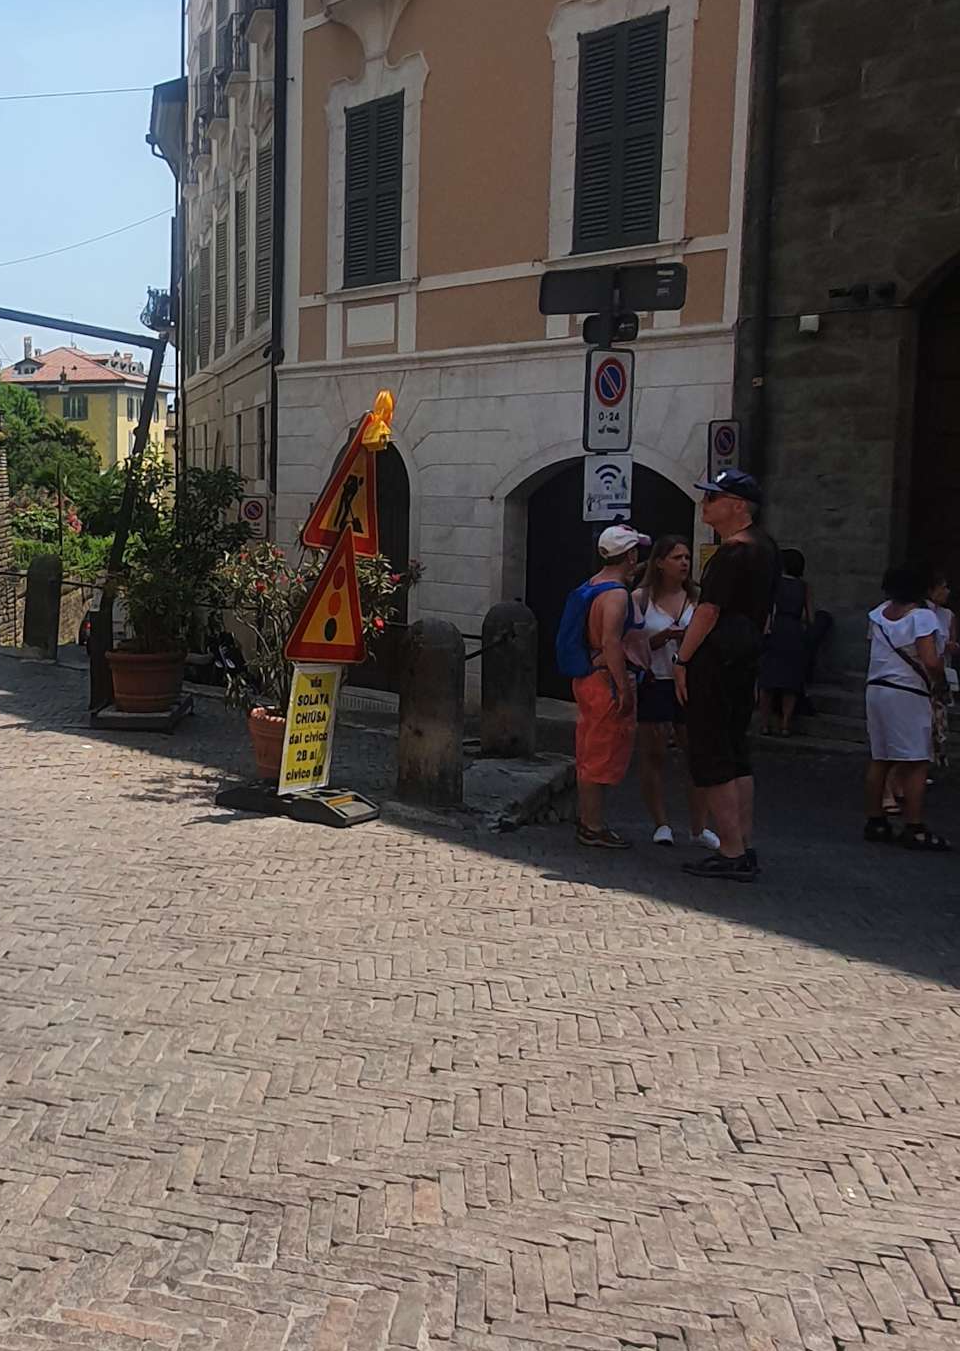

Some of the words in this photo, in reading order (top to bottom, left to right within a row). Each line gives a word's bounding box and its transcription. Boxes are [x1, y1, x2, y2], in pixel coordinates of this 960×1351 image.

[297, 693, 329, 706] SOLATA
[295, 710, 327, 724] CHIUSA
[289, 732, 302, 744] dal
[304, 730, 328, 743] civico
[309, 749, 317, 760] al
[286, 768, 310, 781] civico
